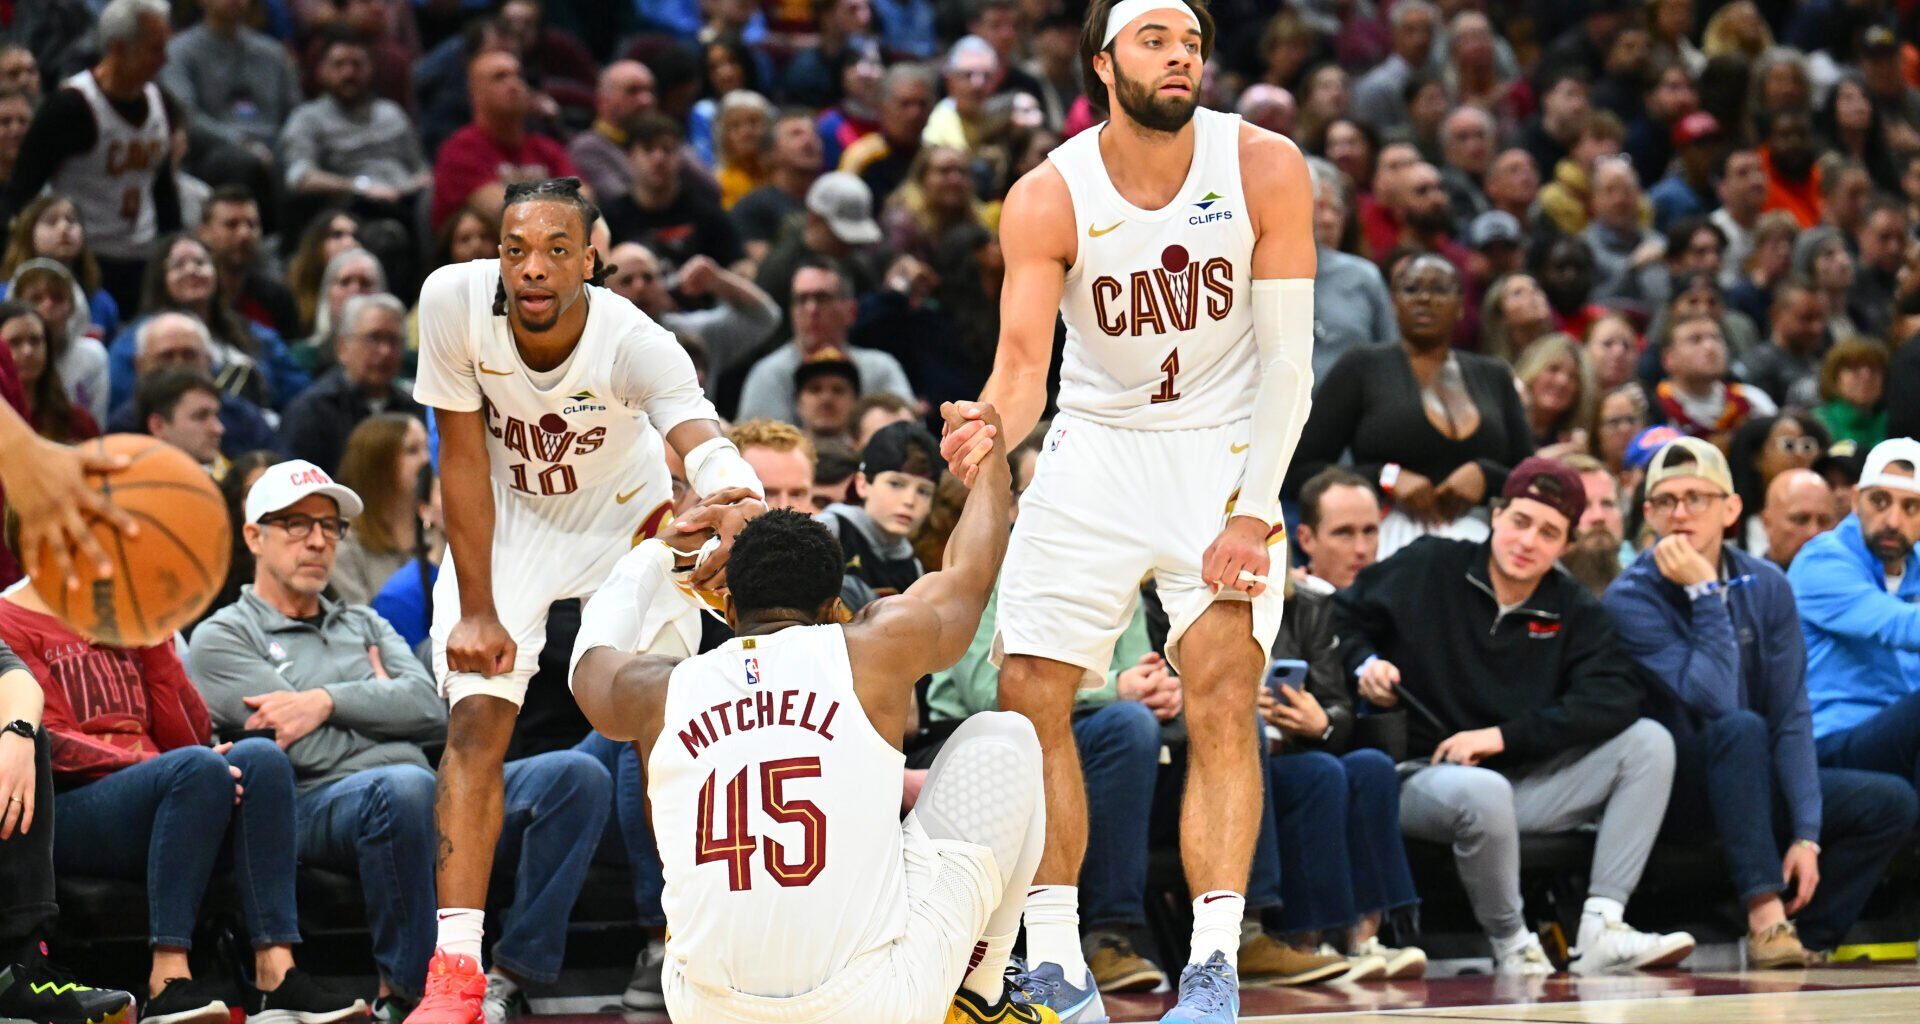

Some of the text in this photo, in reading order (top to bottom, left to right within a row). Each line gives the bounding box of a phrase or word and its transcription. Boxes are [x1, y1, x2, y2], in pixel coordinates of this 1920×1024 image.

[1189, 210, 1233, 226] CLIFFS
[1092, 256, 1233, 337] CAVS
[1150, 346, 1181, 405] 1
[483, 394, 606, 463] CAVS
[563, 404, 606, 415] CLIFFS
[509, 463, 578, 496] 10
[677, 689, 840, 760] MITCHELL
[695, 756, 826, 892] 45
